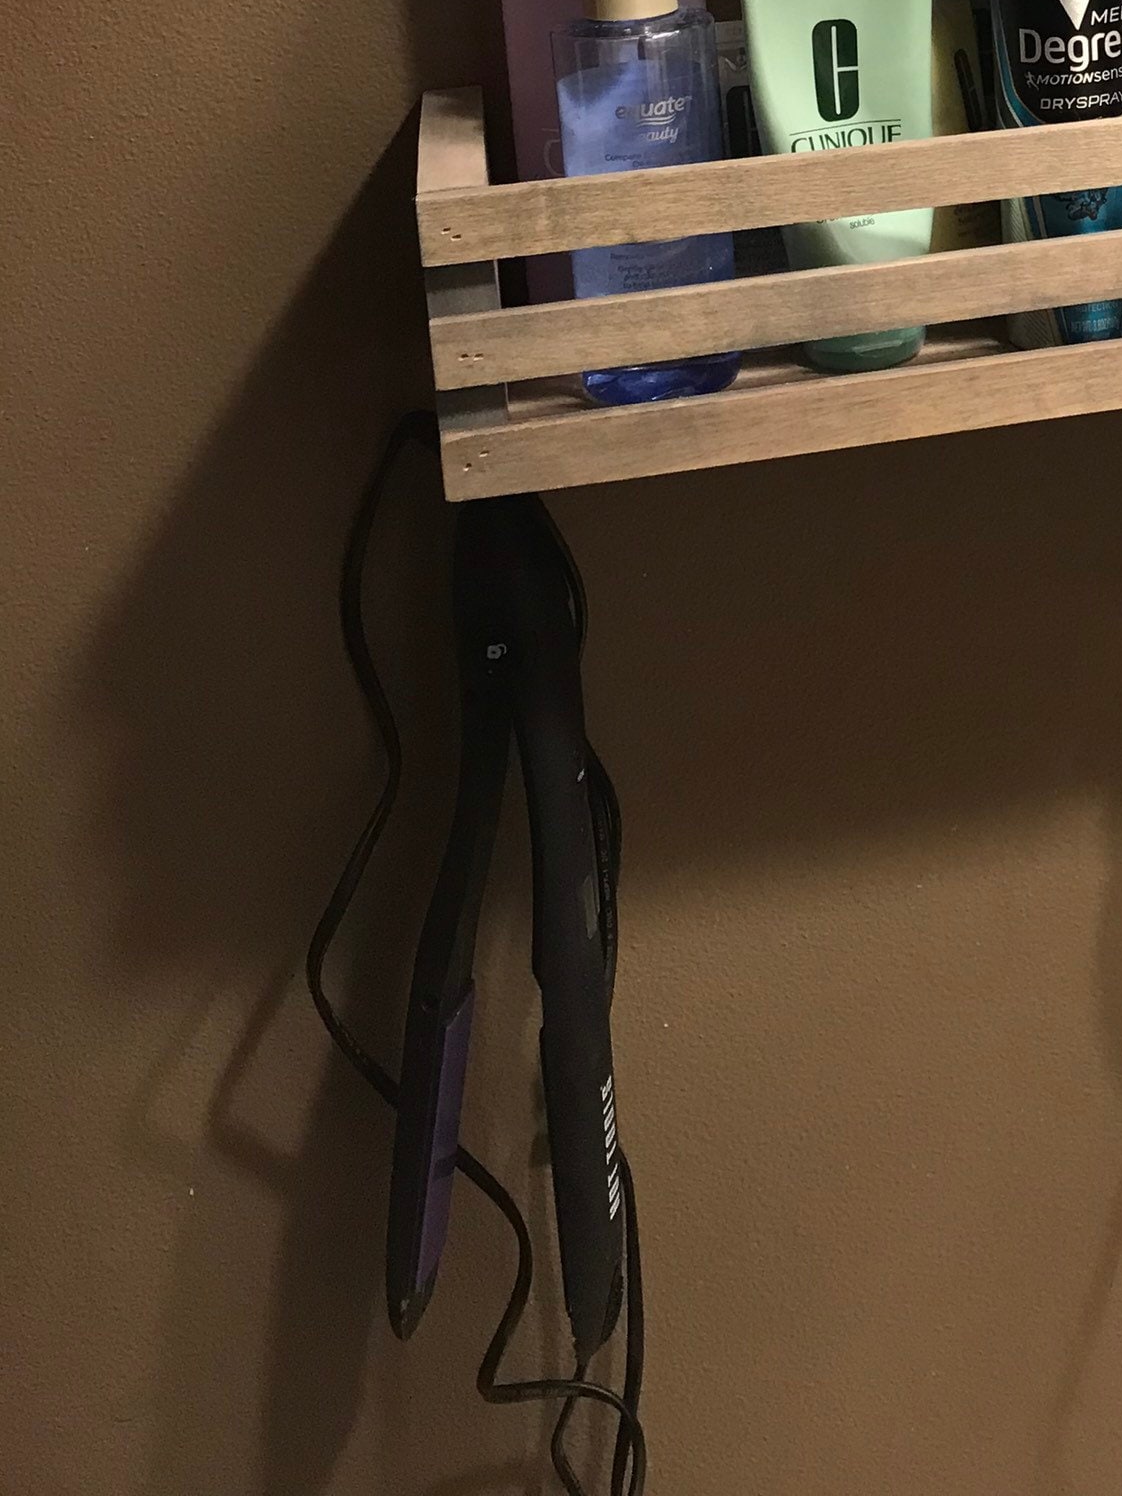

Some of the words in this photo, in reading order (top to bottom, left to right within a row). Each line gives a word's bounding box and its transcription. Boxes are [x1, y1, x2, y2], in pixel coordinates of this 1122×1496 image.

[615, 96, 686, 119] euate
[602, 1074, 617, 1166] TOOLS
[608, 1162, 621, 1221] HOT
